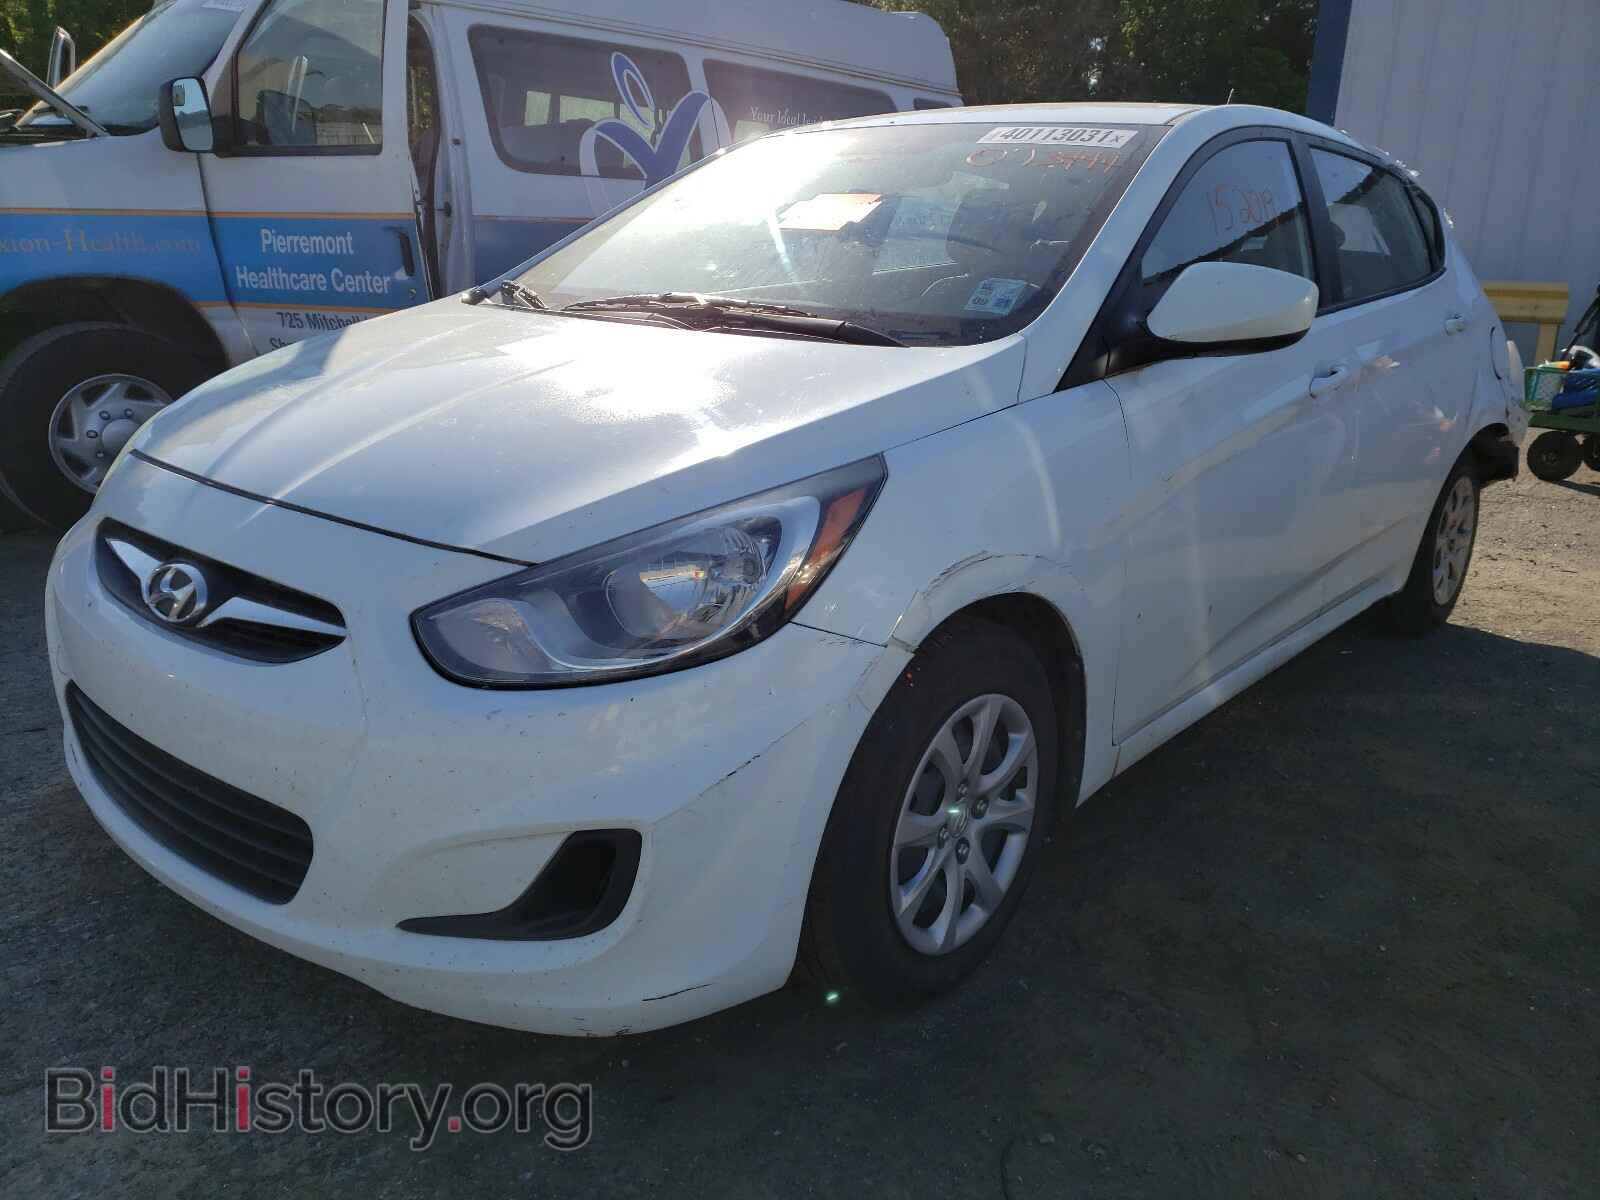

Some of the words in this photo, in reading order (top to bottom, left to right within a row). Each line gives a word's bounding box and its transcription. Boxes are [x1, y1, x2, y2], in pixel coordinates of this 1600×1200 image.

[260, 228, 354, 254] Pierremont
[236, 265, 327, 292] Healthcare
[331, 267, 391, 294] Center
[275, 311, 304, 329] 725
